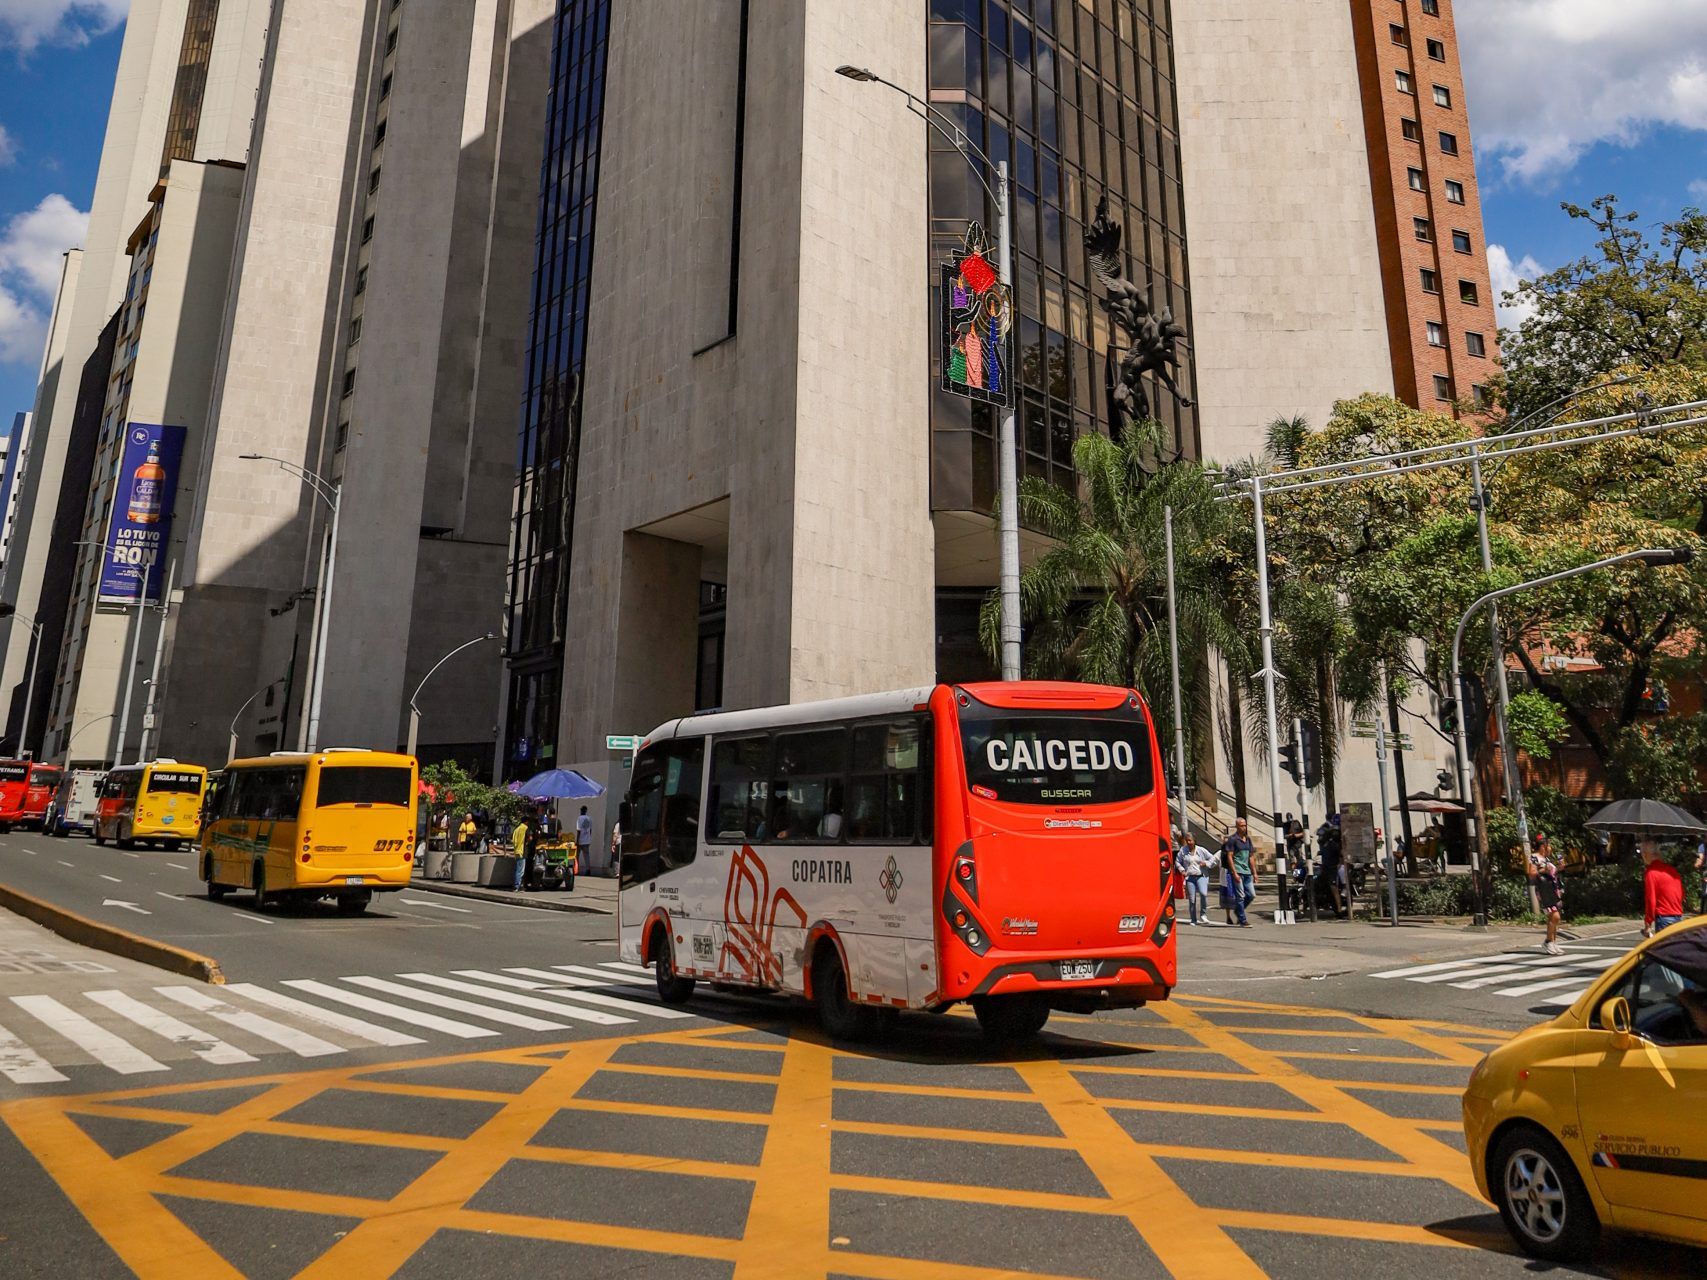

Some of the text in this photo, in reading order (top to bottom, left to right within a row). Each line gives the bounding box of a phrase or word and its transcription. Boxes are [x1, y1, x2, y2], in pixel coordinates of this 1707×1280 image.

[117, 528, 160, 540] LO TUYO
[112, 545, 158, 566] RON
[986, 739, 1134, 771] CAICEDO
[1041, 789, 1092, 798] BUSSCAR
[792, 859, 853, 884] COPATRA
[1593, 1142, 1636, 1154] SERVICIO
